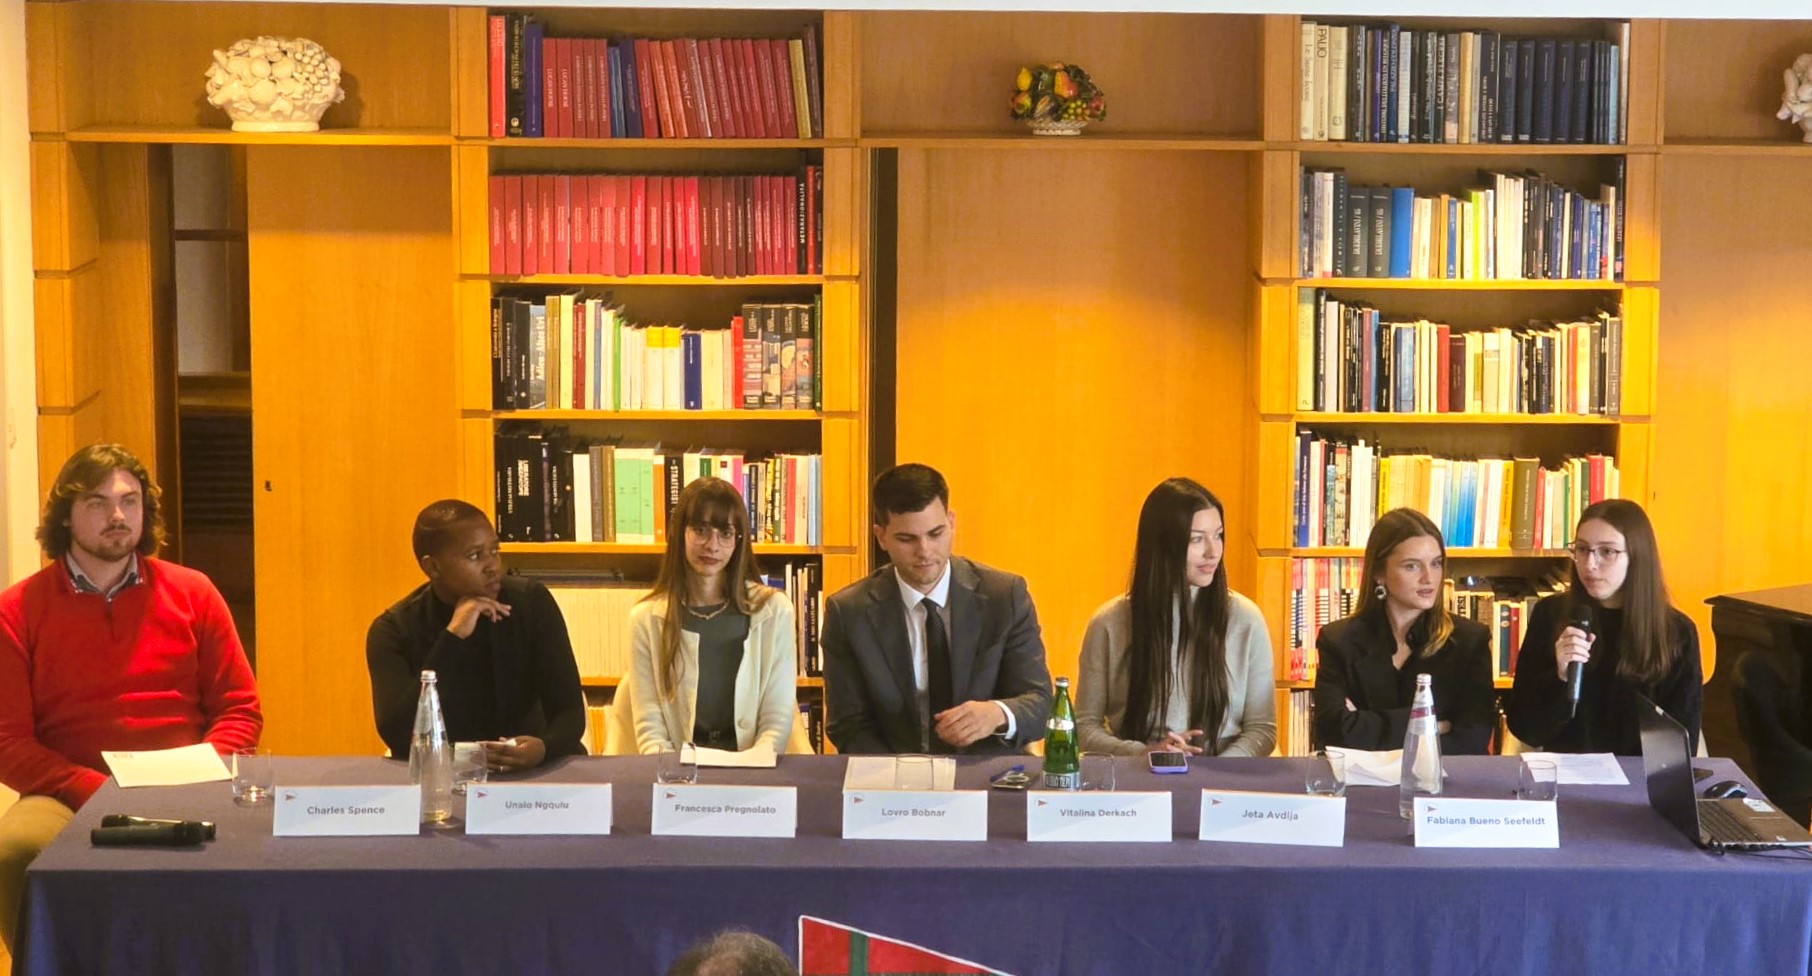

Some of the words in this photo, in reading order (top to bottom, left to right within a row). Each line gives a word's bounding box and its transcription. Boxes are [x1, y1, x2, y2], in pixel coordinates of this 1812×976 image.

[306, 805, 345, 815] Charles
[347, 805, 385, 817] Spence
[674, 803, 723, 814] Francesca
[724, 804, 776, 816] Pregnolato
[881, 808, 909, 817] Lovro
[911, 808, 945, 817] Bobnar
[1059, 808, 1096, 817] Vitalina
[1097, 808, 1137, 817] Derkach
[1241, 809, 1264, 819] Jeta
[1266, 810, 1299, 822] Avdija
[1426, 815, 1467, 825] Fabiana
[1469, 816, 1501, 825] Bueno
[1503, 816, 1546, 825] Seefeldt
